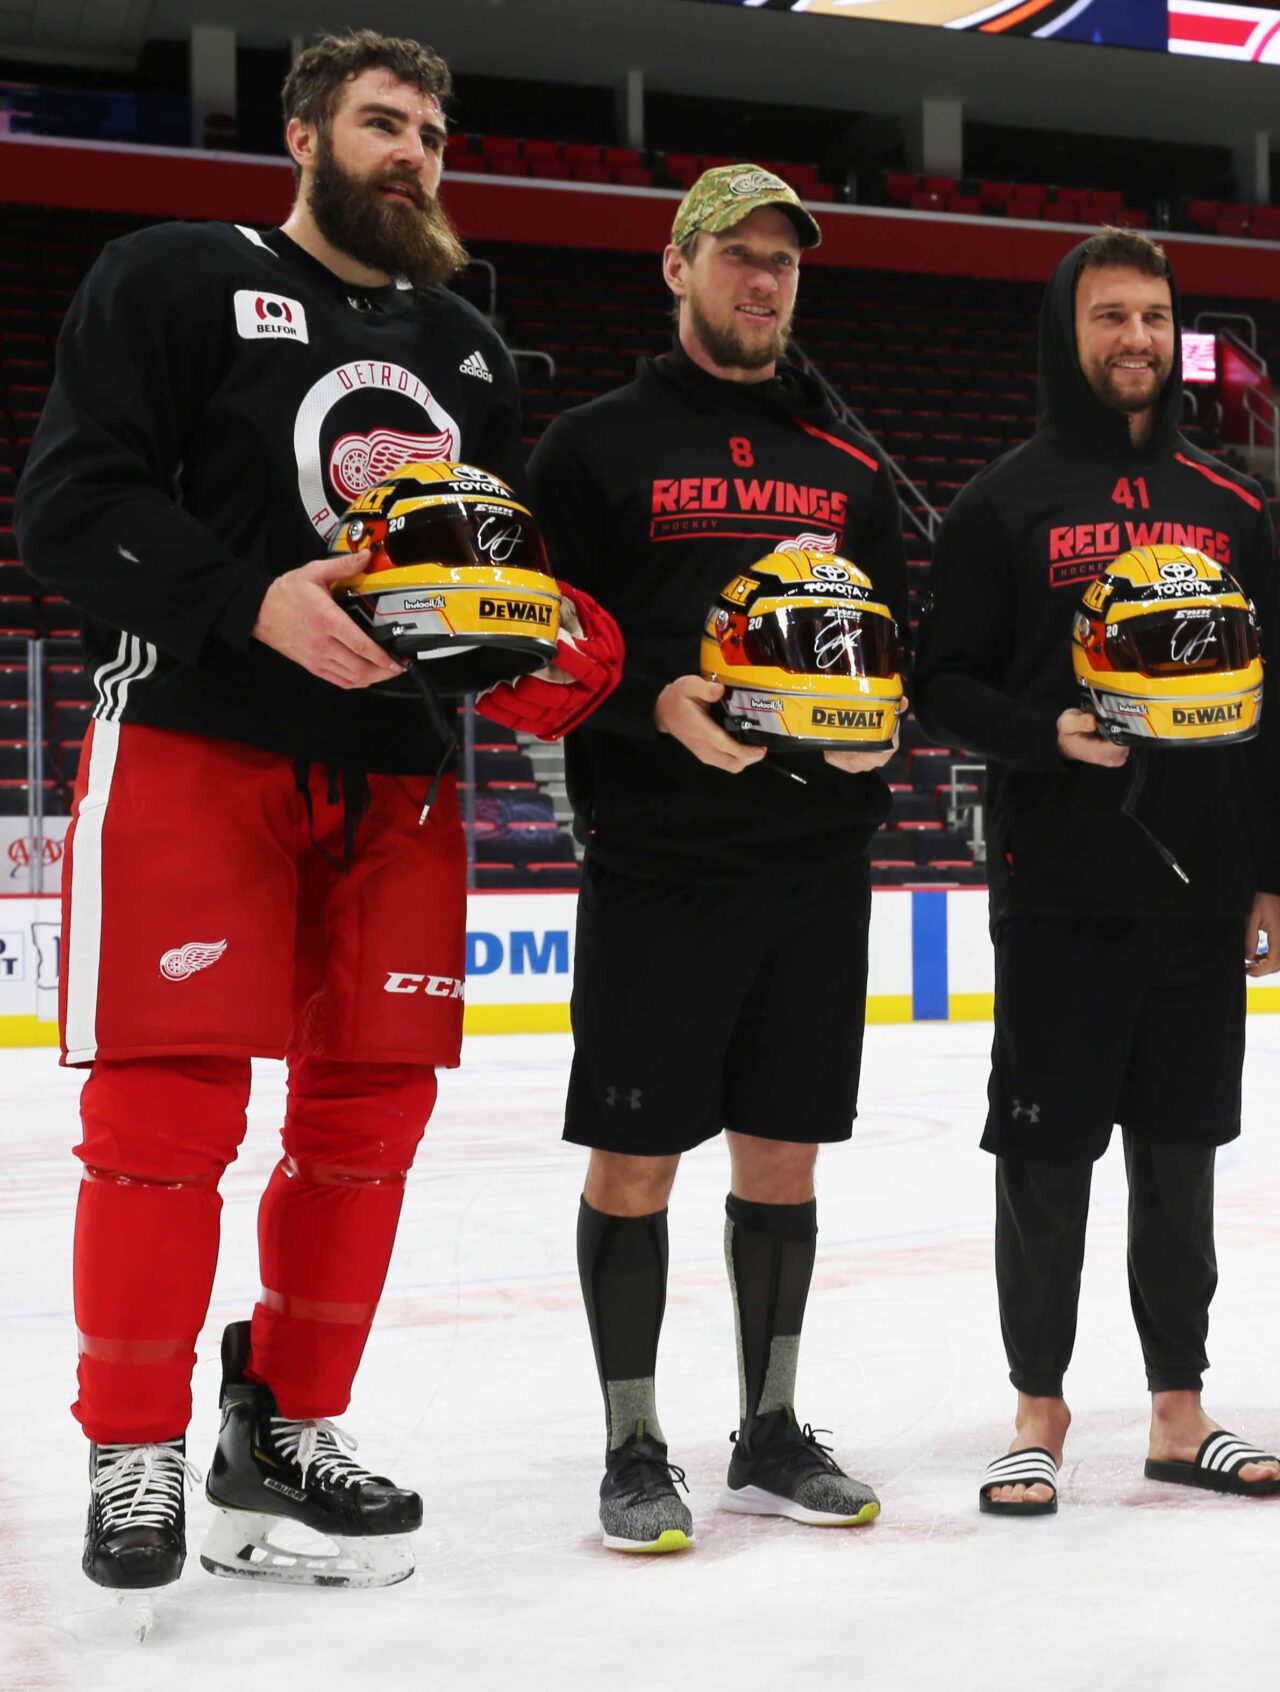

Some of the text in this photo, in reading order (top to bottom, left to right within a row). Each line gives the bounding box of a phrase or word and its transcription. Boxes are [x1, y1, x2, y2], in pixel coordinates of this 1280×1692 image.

[256, 324, 297, 336] BELFOR
[459, 363, 493, 383] adidas
[336, 362, 431, 406] DETROIT
[729, 436, 754, 468] 8
[449, 480, 511, 498] TOYOTA
[1112, 476, 1151, 510] 41
[652, 477, 848, 525] RED WINGS
[388, 516, 405, 533] 20
[662, 519, 719, 532] HOCKEY
[1050, 521, 1231, 564] RED WINGS
[804, 582, 863, 597] TOYOTA
[1154, 581, 1212, 596] TOYOTA
[748, 616, 763, 631] 20
[1106, 624, 1118, 638] 20
[465, 930, 569, 976] DM
[383, 972, 465, 1001] CCM
